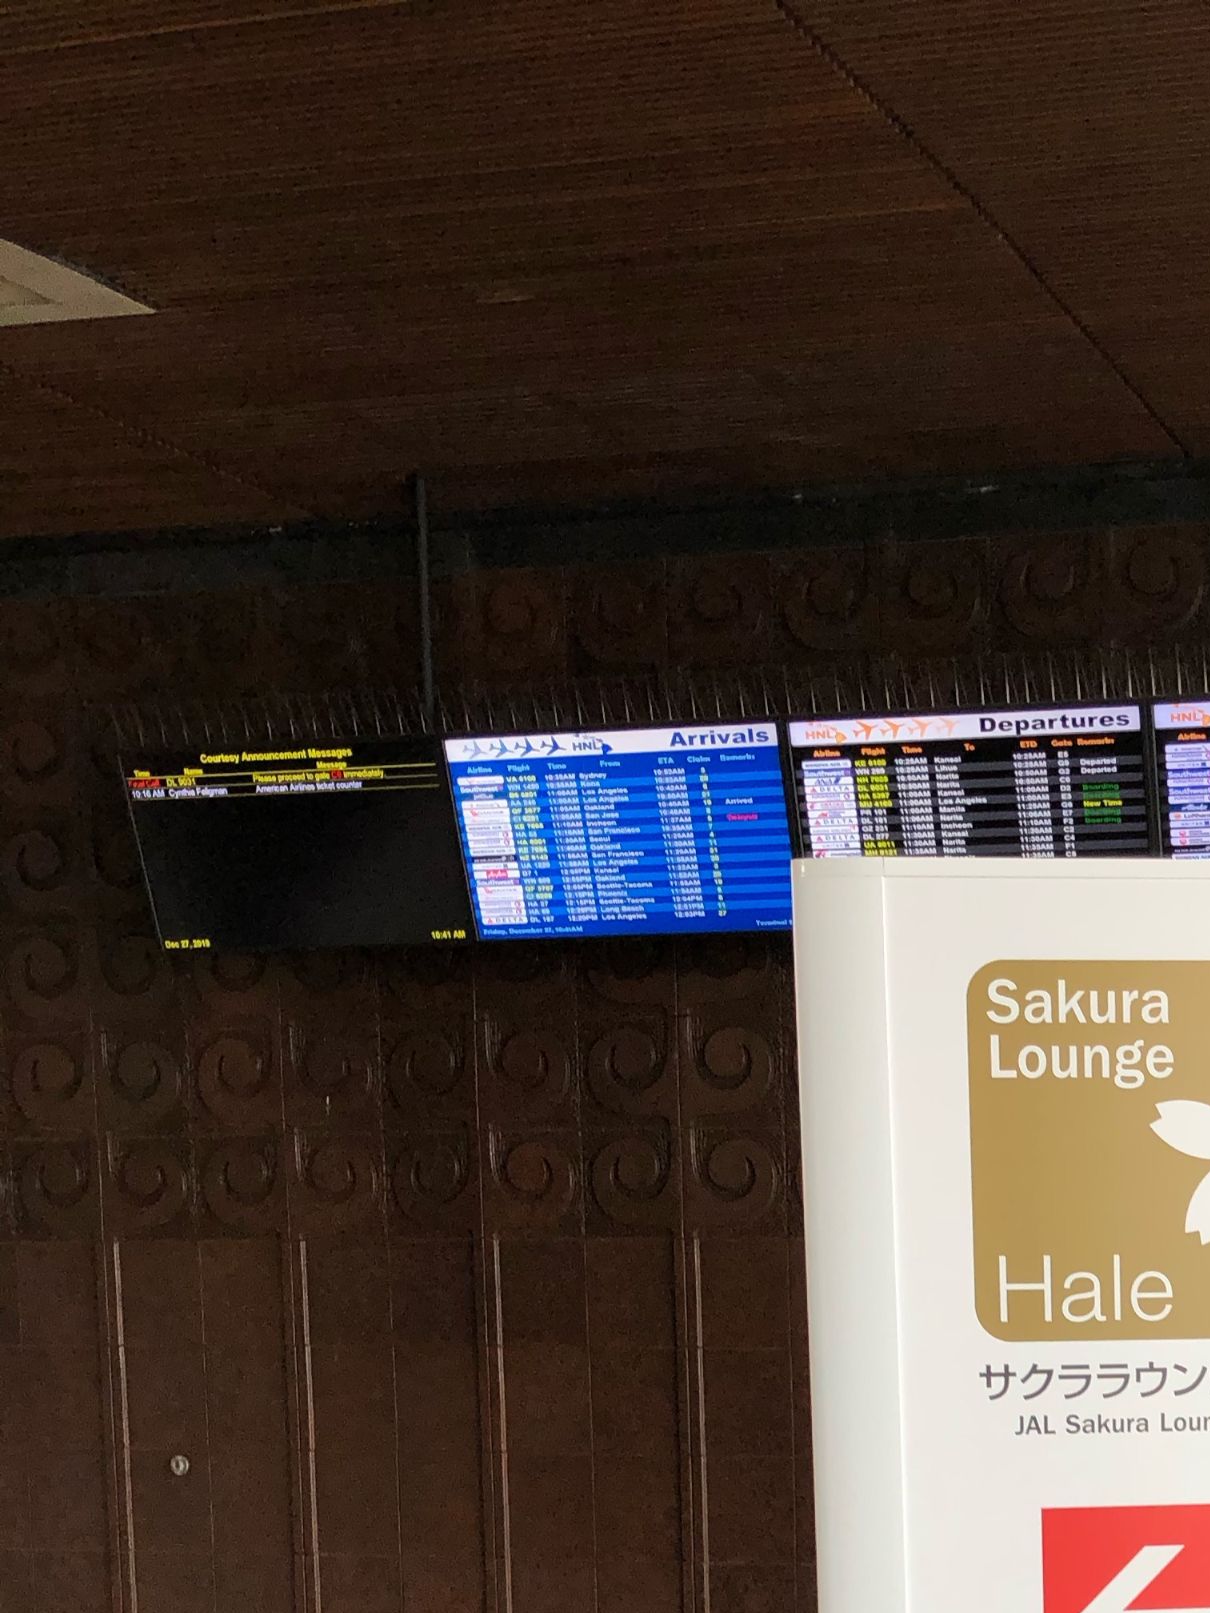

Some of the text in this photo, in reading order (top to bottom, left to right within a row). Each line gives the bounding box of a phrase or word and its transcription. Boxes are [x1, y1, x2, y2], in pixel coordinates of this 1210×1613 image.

[979, 711, 1130, 735] Departures
[670, 728, 769, 748] Arrivals
[573, 740, 600, 752] HNL
[965, 743, 975, 751] To
[200, 748, 352, 764] Courtesy Announcement Messages
[1080, 758, 1116, 766] Departed
[1081, 766, 1117, 774] Departed
[278, 772, 305, 782] proceed
[256, 784, 288, 792] American
[290, 783, 315, 791] Airlines
[337, 781, 362, 789] counter
[153, 789, 165, 797] AM
[957, 797, 987, 805] Angeles
[453, 930, 465, 939] AM
[986, 979, 1170, 1024] Sakura
[990, 1034, 1174, 1089] Lounge
[998, 1254, 1174, 1323] Hale
[1014, 1415, 1056, 1436] JAL
[1066, 1413, 1149, 1435] Sakura
